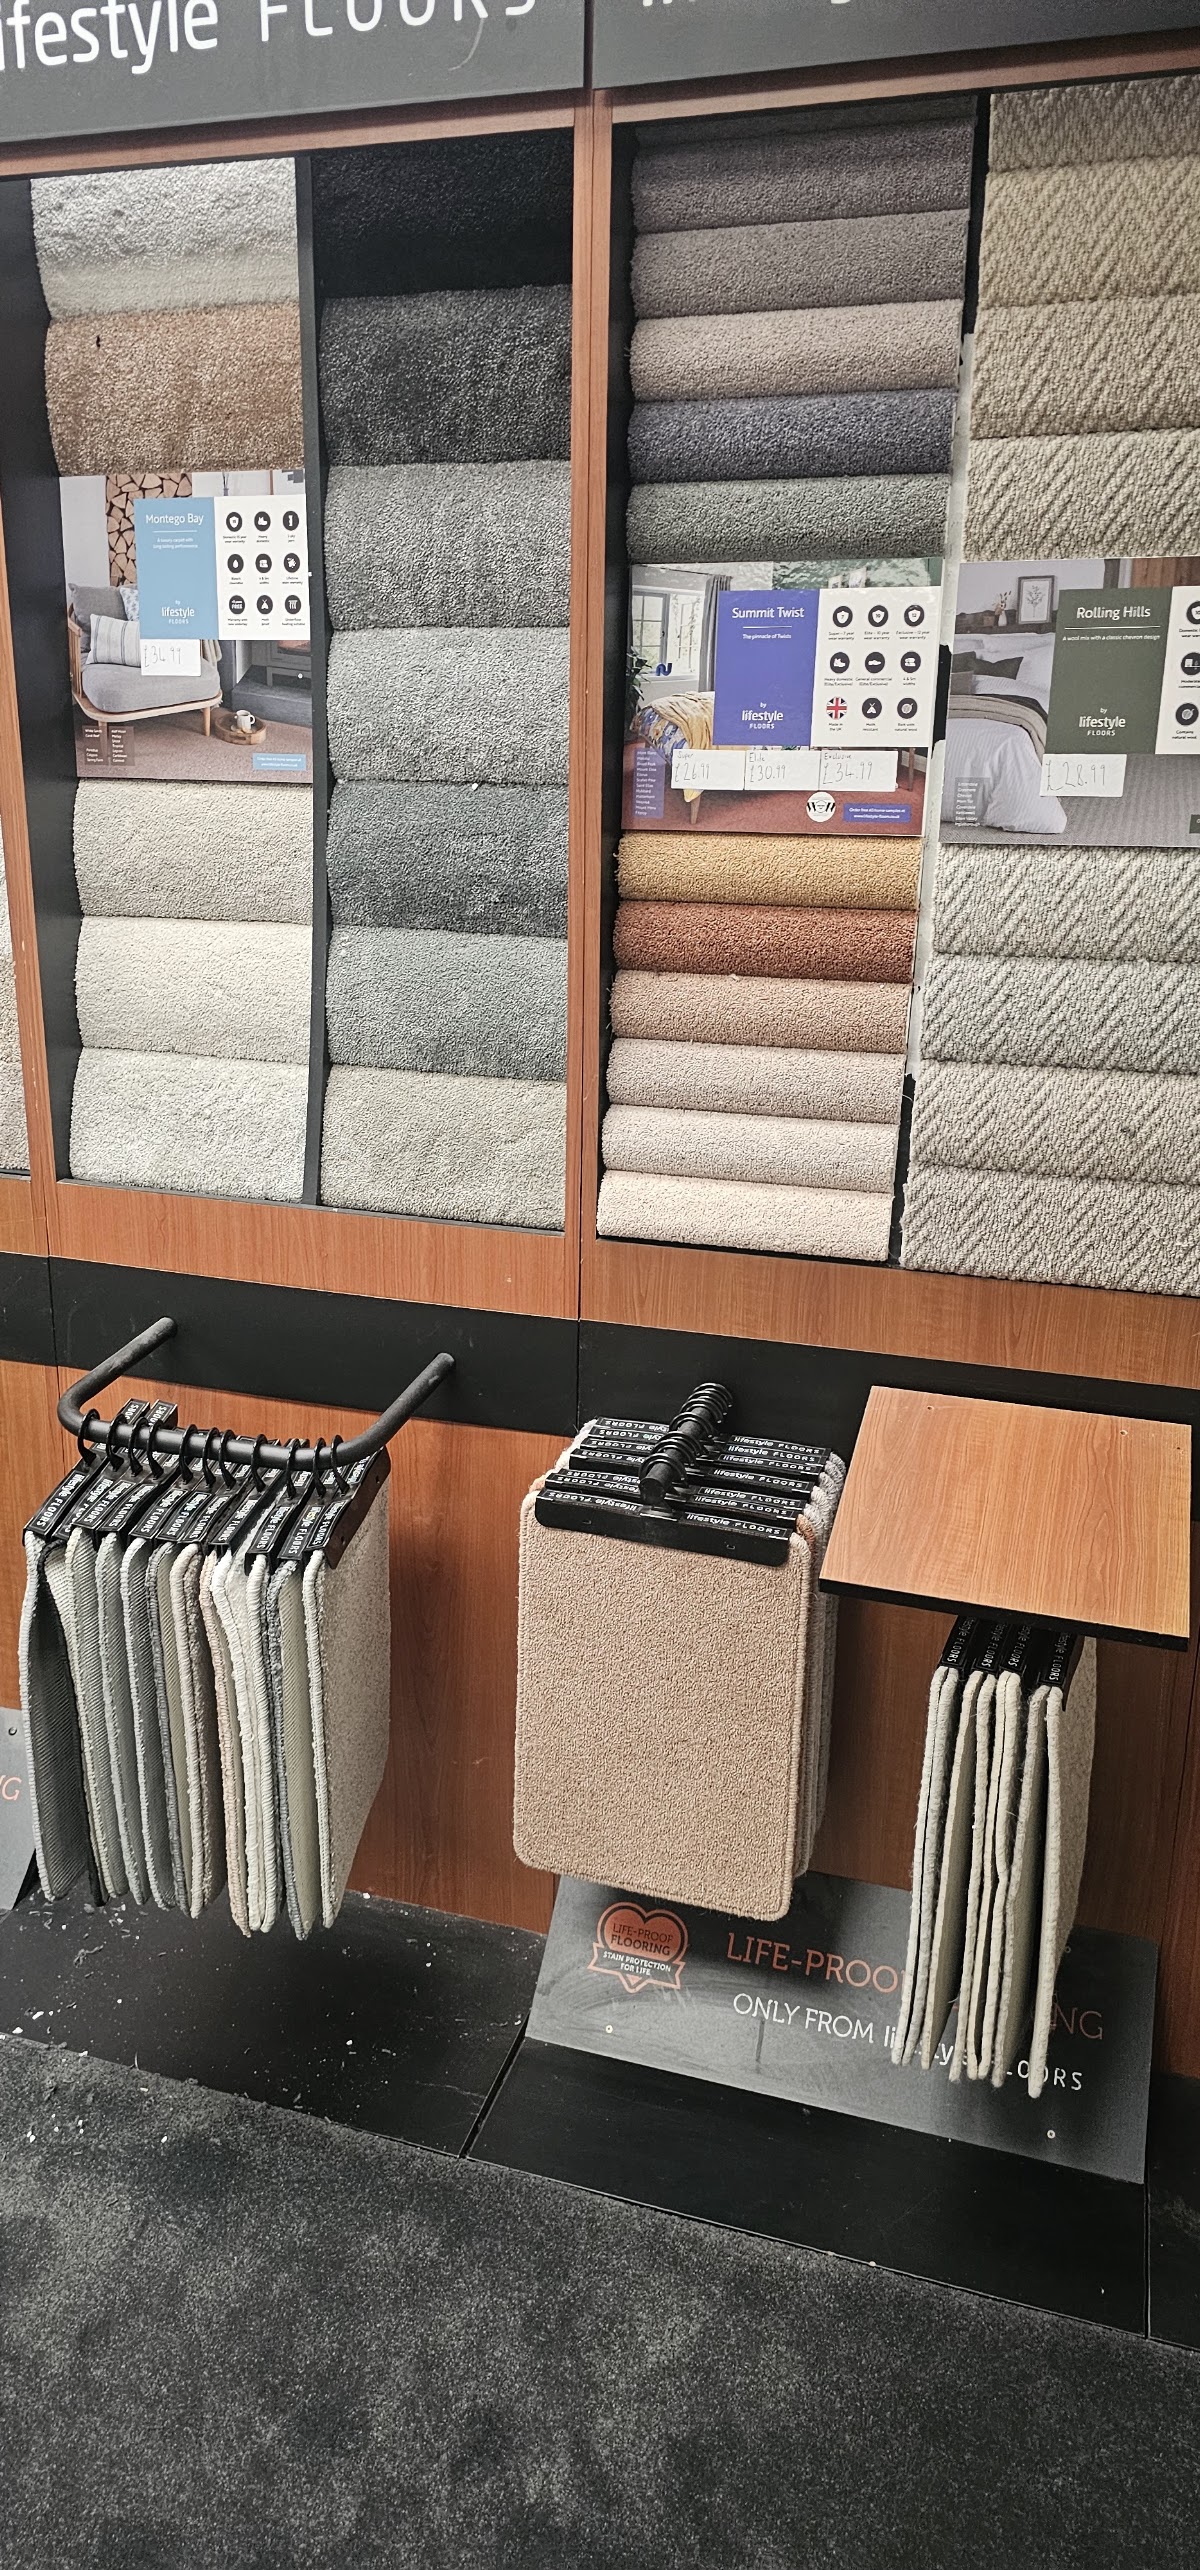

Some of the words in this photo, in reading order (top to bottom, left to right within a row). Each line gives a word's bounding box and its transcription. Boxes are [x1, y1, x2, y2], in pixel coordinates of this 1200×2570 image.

[146, 514, 185, 526] Montego
[188, 513, 204, 526] Bay
[162, 607, 194, 618] lifestyle
[732, 607, 774, 618] Summit
[777, 606, 805, 618] Twist
[1077, 606, 1120, 620] Rolling
[1123, 606, 1151, 618] Hills
[742, 710, 783, 723] lifestyle
[1079, 716, 1126, 730] lifestyle
[678, 751, 693, 760] Super
[750, 764, 786, 782] £30.99
[1045, 760, 1105, 791] £28.99
[599, 1430, 639, 1438] FLOORS
[728, 1445, 768, 1456] lifestyle
[773, 1452, 815, 1462] FLOORS
[734, 1436, 774, 1447] lifestyle
[778, 1443, 820, 1454] FLOORS
[581, 1451, 623, 1459] FLOORS
[723, 1455, 764, 1465] lifestyle
[768, 1461, 812, 1470] FLOORS
[557, 1476, 600, 1486] FLOORS
[567, 1471, 608, 1479] FLOORS
[714, 1469, 755, 1480] lifestyle
[759, 1477, 803, 1488] FLOORS
[604, 1482, 640, 1493] festyle
[595, 1499, 637, 1511] lifestyle
[694, 1496, 738, 1506] lifestyle
[742, 1503, 787, 1515] FLOORS
[704, 1488, 746, 1499] lifestyle
[750, 1495, 795, 1506] FLOORS
[36, 1497, 63, 1527] FLOORS
[84, 1500, 110, 1523] FLOORS
[141, 1508, 164, 1533] FLOORS
[686, 1513, 730, 1526] lifestyle
[735, 1522, 780, 1535] FLOORS
[257, 1524, 276, 1549] FLOORS
[288, 1528, 308, 1554] FLOORS
[947, 1638, 965, 1663] FLOORS
[981, 1642, 999, 1668] FLOORS
[1008, 1642, 1026, 1667] FLOORS
[1049, 1655, 1064, 1681] FLOORS
[613, 1923, 674, 1943] LIFE-PROOF
[611, 1934, 670, 1955] FLOORING
[603, 1951, 624, 1962] STAIN
[626, 1956, 671, 1972] PROTECTION
[620, 1963, 634, 1972] FOR
[636, 1966, 650, 1976] LIFE
[727, 1933, 905, 1993] LIFE-PROO
[733, 1993, 800, 2025] ONLY
[805, 2007, 874, 2044] FROM
